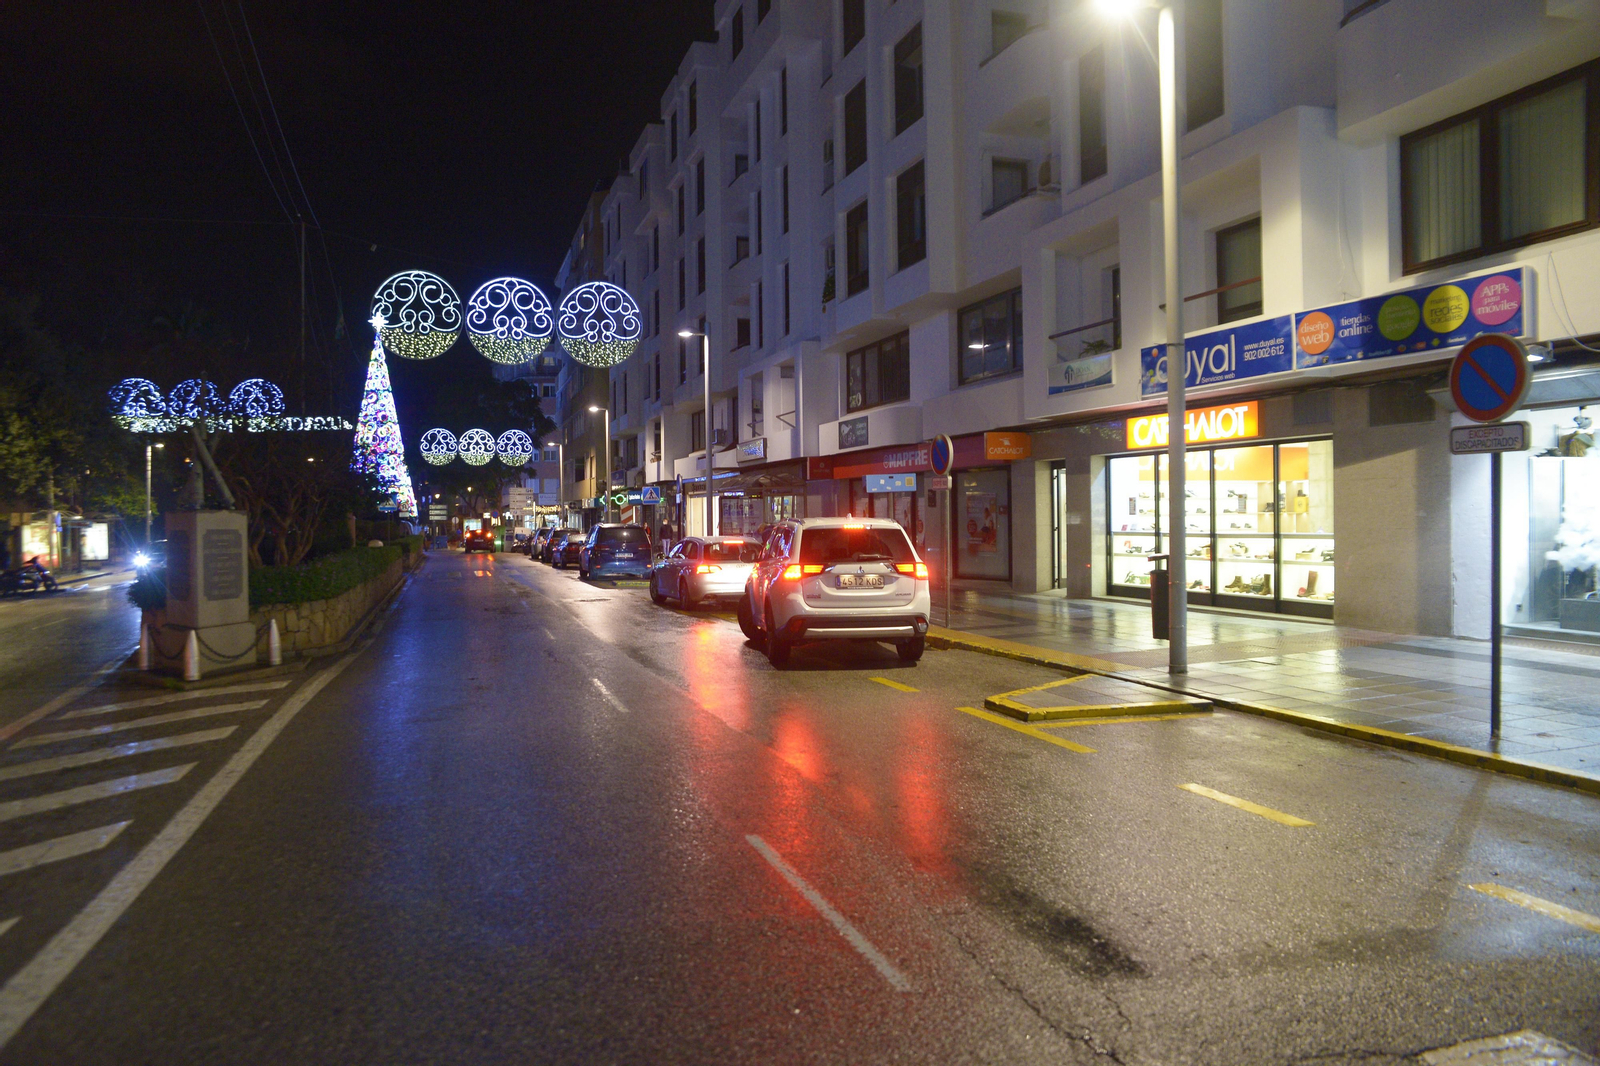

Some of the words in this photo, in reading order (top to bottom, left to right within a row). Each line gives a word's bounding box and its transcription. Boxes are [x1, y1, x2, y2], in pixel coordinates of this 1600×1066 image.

[1480, 283, 1509, 298] APPs
[1430, 303, 1463, 317] redes
[1477, 299, 1518, 315] móviles
[1341, 313, 1371, 326] tiendas
[1301, 321, 1329, 333] diseño
[1339, 324, 1373, 338] online
[1244, 337, 1284, 351] www.duyal.es
[1302, 331, 1330, 345] web
[1244, 350, 1256, 361] 902
[1257, 348, 1271, 358] 002
[1271, 345, 1285, 355] 612
[1201, 374, 1223, 383] Servicios
[1224, 372, 1235, 380] web
[1133, 406, 1248, 446] CATHALOT
[1469, 428, 1504, 438] EXCEPTO
[1455, 437, 1519, 449] DISCAPACITADOS
[989, 447, 1024, 455] CATCHALOT
[889, 449, 928, 468] MAPFRE
[842, 577, 864, 585] 4512
[866, 577, 882, 585] KDS
